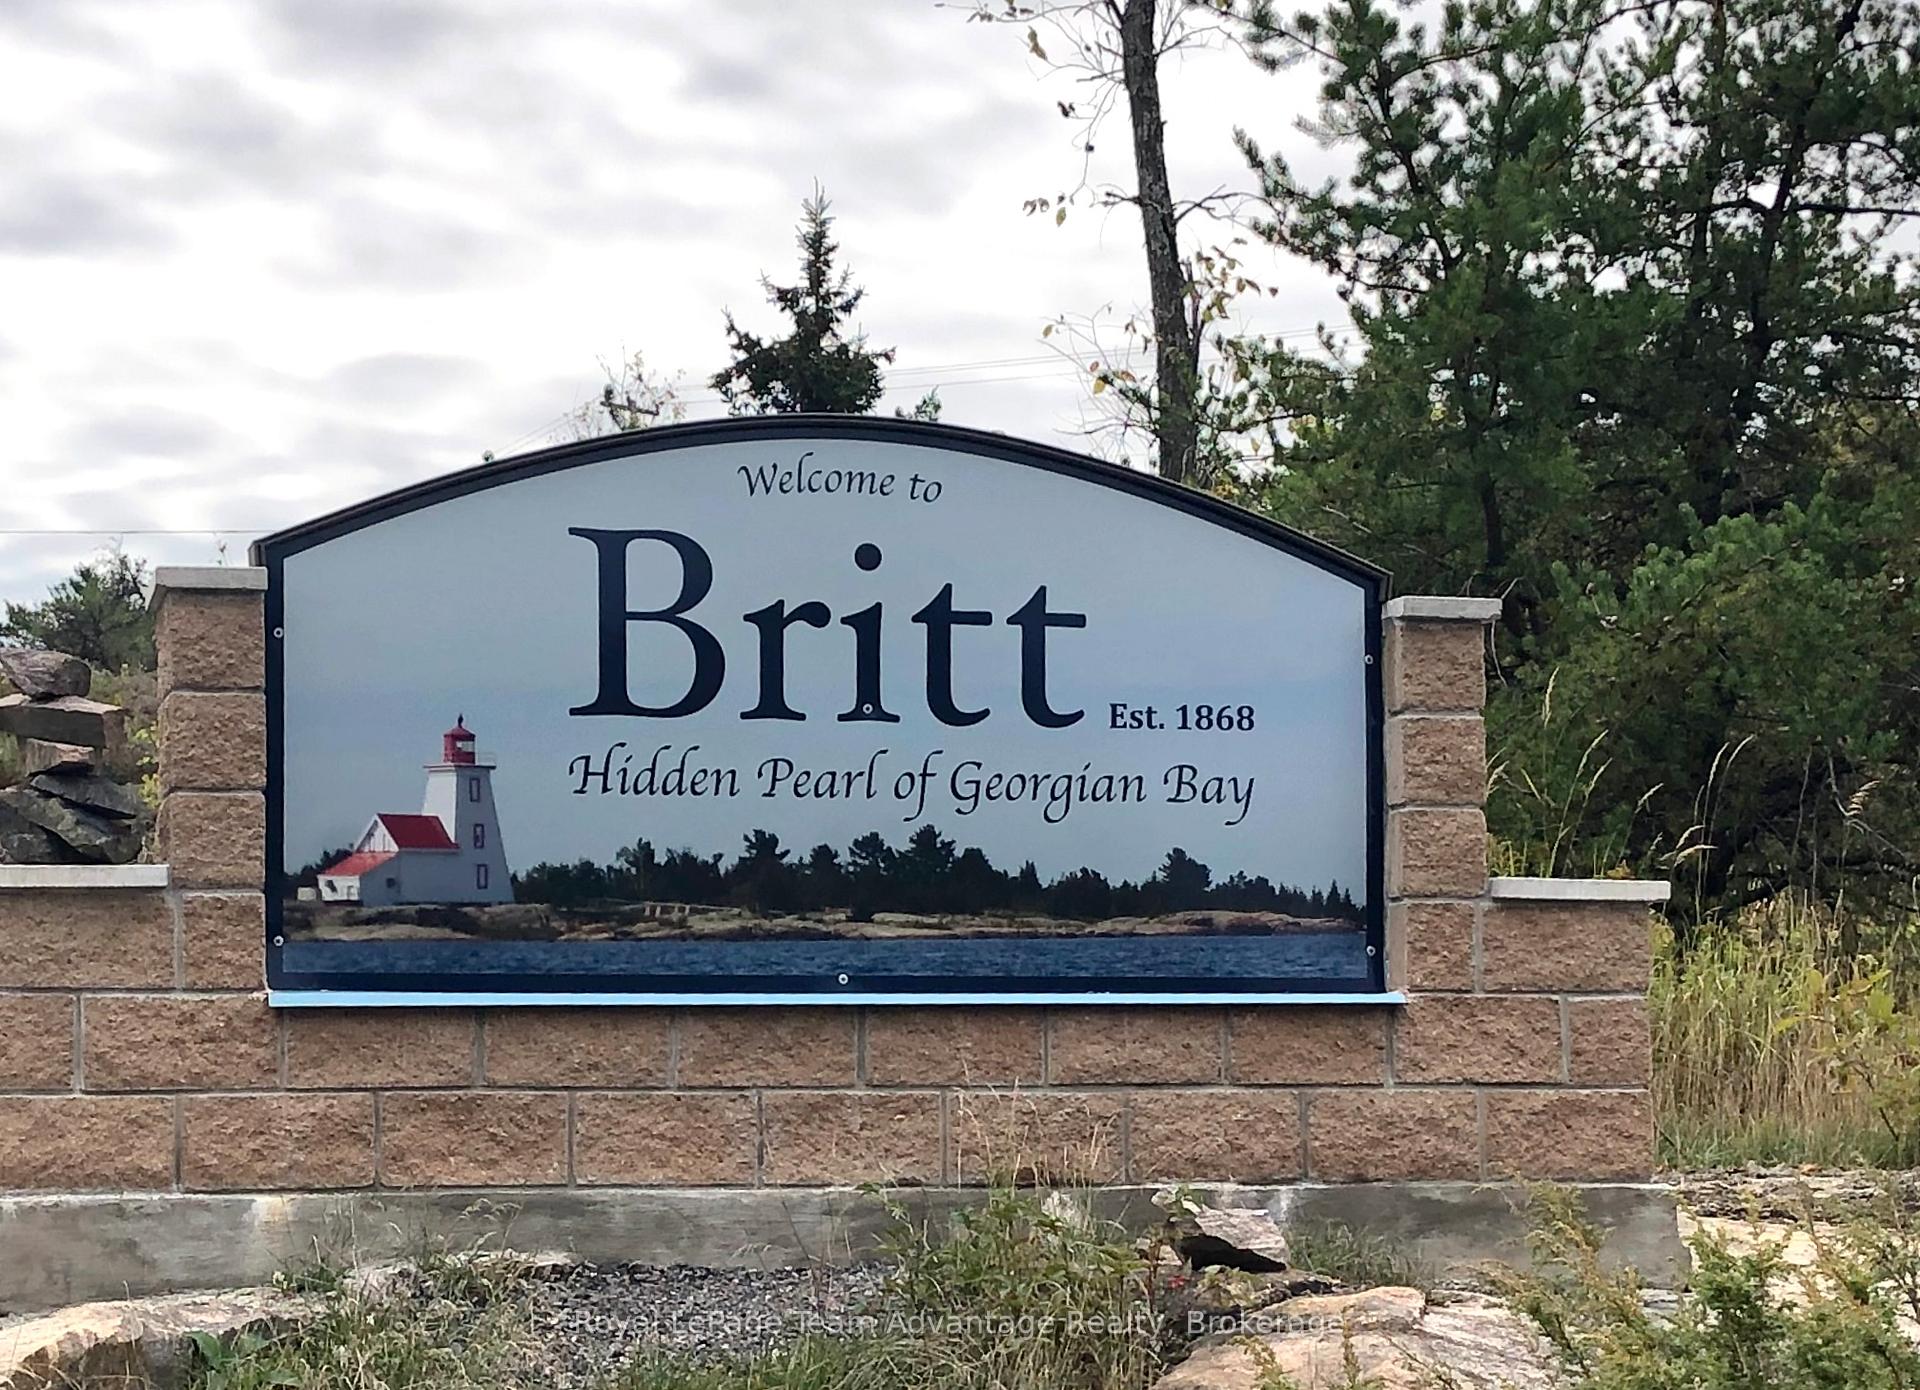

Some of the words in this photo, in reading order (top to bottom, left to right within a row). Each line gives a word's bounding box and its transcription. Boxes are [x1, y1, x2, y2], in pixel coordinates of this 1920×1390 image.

[737, 452, 896, 497] Welcome
[910, 474, 943, 503] to
[568, 527, 1087, 728] Britt
[1110, 703, 1165, 730] Est.
[1176, 704, 1255, 731] 1868
[568, 742, 741, 798] Hidden
[757, 749, 889, 799] Pearl
[893, 750, 943, 823] of
[949, 760, 1148, 824] Georgian
[1163, 764, 1255, 826] Bay
